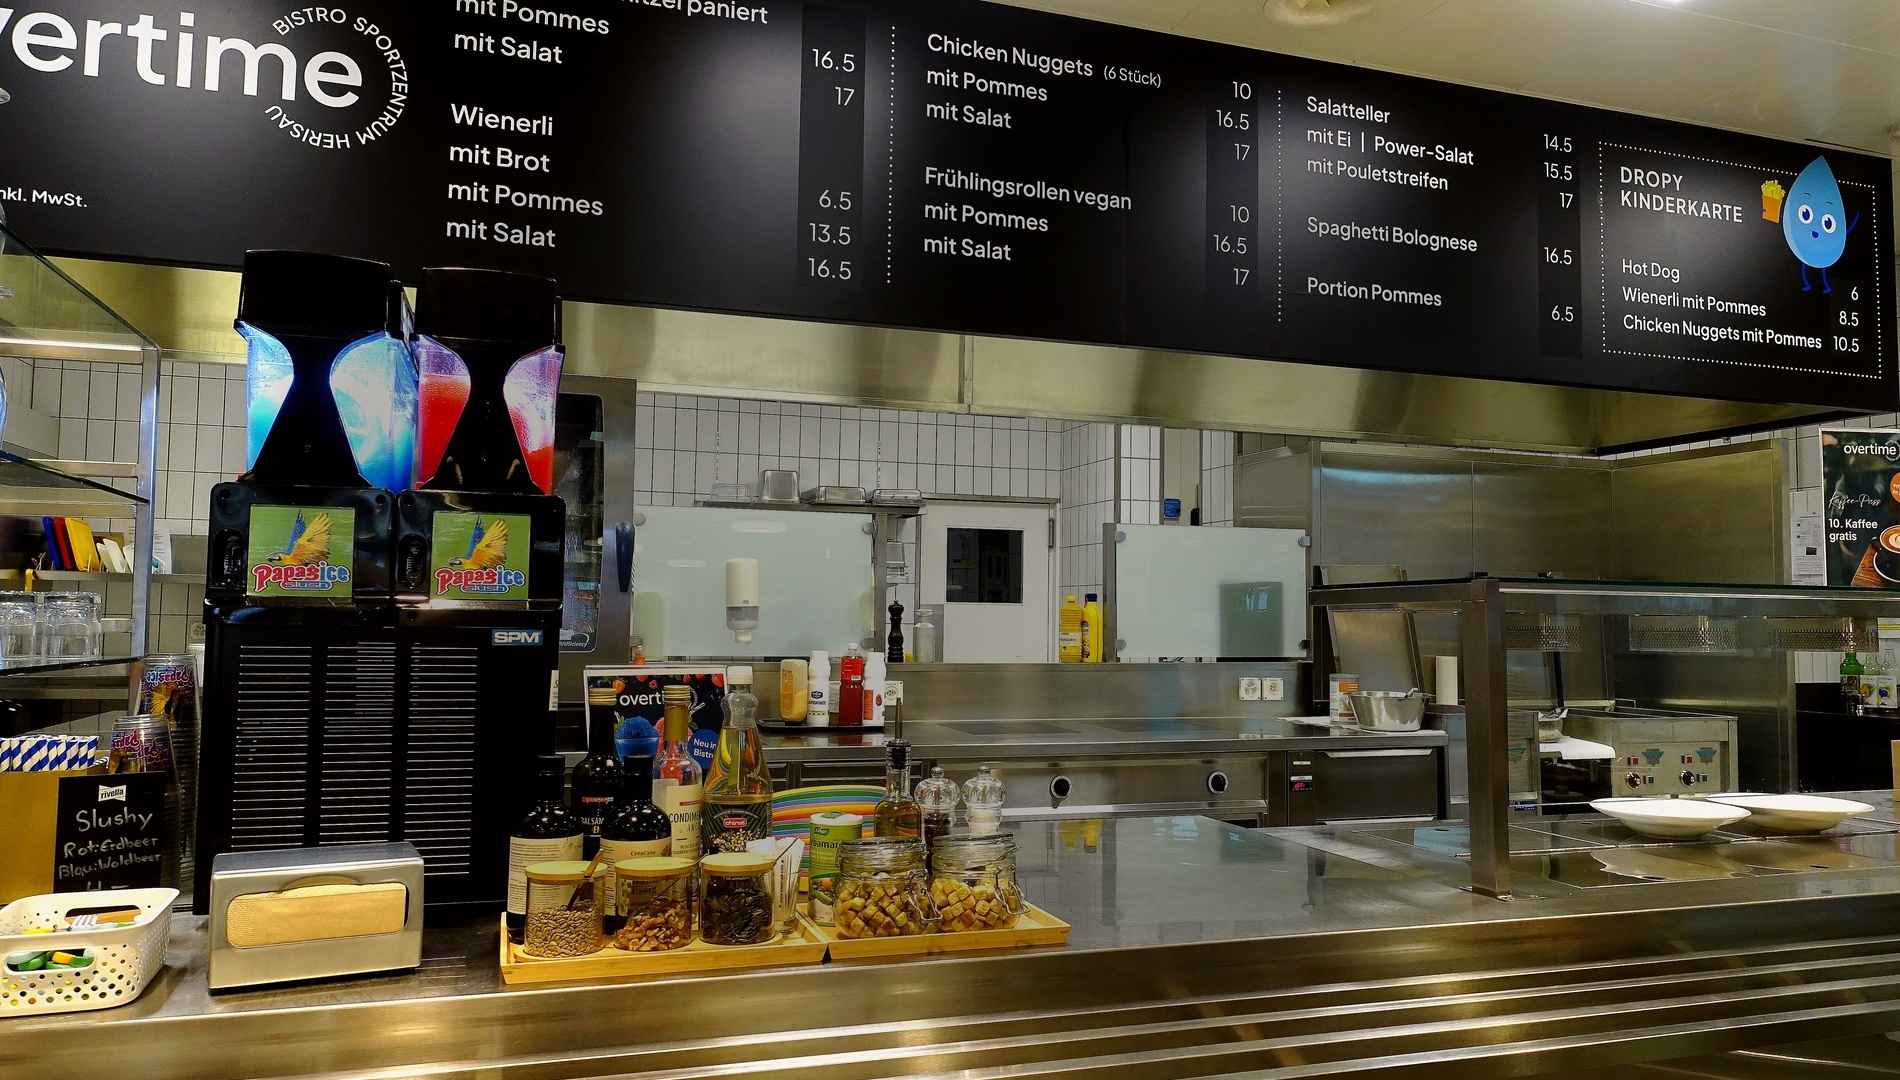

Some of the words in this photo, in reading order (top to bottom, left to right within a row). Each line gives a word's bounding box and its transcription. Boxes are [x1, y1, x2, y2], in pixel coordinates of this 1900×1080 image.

[272, 7, 347, 36] BISTRO
[457, 0, 496, 16] mit
[503, 0, 609, 34] Pommes
[687, 0, 768, 24] paniert
[0, 7, 363, 108] ertime
[455, 33, 494, 53] mit
[501, 37, 562, 63] Salat
[813, 49, 854, 72] 16.5
[928, 34, 1007, 62] Chicken
[1013, 47, 1092, 76] Nuggets
[1104, 66, 1116, 80] (6
[1119, 68, 1161, 88] Stück)
[353, 17, 408, 145] SPORTZENTRUM
[927, 69, 958, 87] mit
[964, 72, 1047, 101] Pommes
[1233, 82, 1251, 99] 10
[835, 87, 854, 105] 17
[451, 104, 552, 135] Wienerli
[927, 102, 958, 121] mit
[963, 105, 1011, 128] Salat
[1217, 110, 1249, 130] 16.5
[1307, 96, 1390, 123] Salatteller
[265, 105, 351, 149] HERISAU
[1235, 144, 1250, 160] 17
[1308, 128, 1333, 144] mit
[1338, 131, 1350, 147] Ei
[1375, 136, 1473, 165] Power-Salat
[1544, 134, 1572, 152] 14.5
[450, 145, 490, 165] mit
[497, 147, 549, 172] Brot
[1308, 158, 1333, 174] mit
[1337, 160, 1447, 190] Pouletstreifen
[1544, 162, 1572, 180] 15.5
[1621, 167, 1683, 191] DROPY
[32, 189, 88, 208] MwSt.
[448, 182, 488, 202] mit
[496, 185, 603, 215] Pommes
[819, 190, 851, 210] 6.5
[926, 167, 1069, 202] Frühlingsrollen
[1074, 190, 1131, 210] vegan
[1560, 193, 1573, 208] 17
[1622, 190, 1742, 222] KINDERKARTE
[925, 203, 957, 221] mit
[962, 205, 1048, 231] Pommes
[1231, 205, 1249, 223] 10
[447, 220, 487, 240] mit
[494, 222, 555, 247] Salat
[810, 223, 850, 245] 13.5
[1214, 235, 1246, 254] 16.5
[1308, 217, 1388, 241] Spaghetti
[1393, 227, 1477, 251] Bolognese
[925, 237, 956, 254] mit
[962, 239, 1011, 260] Salat
[1545, 247, 1572, 264] 16.5
[809, 258, 851, 279] 16.5
[1234, 269, 1249, 285] 17
[1623, 259, 1647, 275] Hot
[1651, 263, 1679, 283] Dog
[1308, 277, 1367, 299] Portion
[1372, 284, 1441, 306] Pommes
[1623, 286, 1679, 306] Wienerli
[1683, 295, 1704, 309] mit
[1708, 296, 1766, 316] Pommes
[1851, 287, 1858, 300] 6
[1552, 306, 1573, 321] 6.5
[1840, 311, 1858, 326] 8.5
[1624, 315, 1679, 334] Chicken
[1683, 321, 1739, 341] Nuggets
[1743, 328, 1763, 342] mit
[1766, 330, 1821, 348] Pommes
[1834, 336, 1859, 352] 10.5
[1843, 443, 1897, 456] overtime
[1829, 518, 1843, 529] 10.
[1845, 518, 1878, 529] Kaffee
[1829, 531, 1857, 543] gratis
[494, 631, 540, 644] SPM
[693, 738, 709, 748] Neu
[693, 749, 714, 759] Bistr
[101, 789, 124, 799] rivella
[75, 807, 153, 832] Slushy
